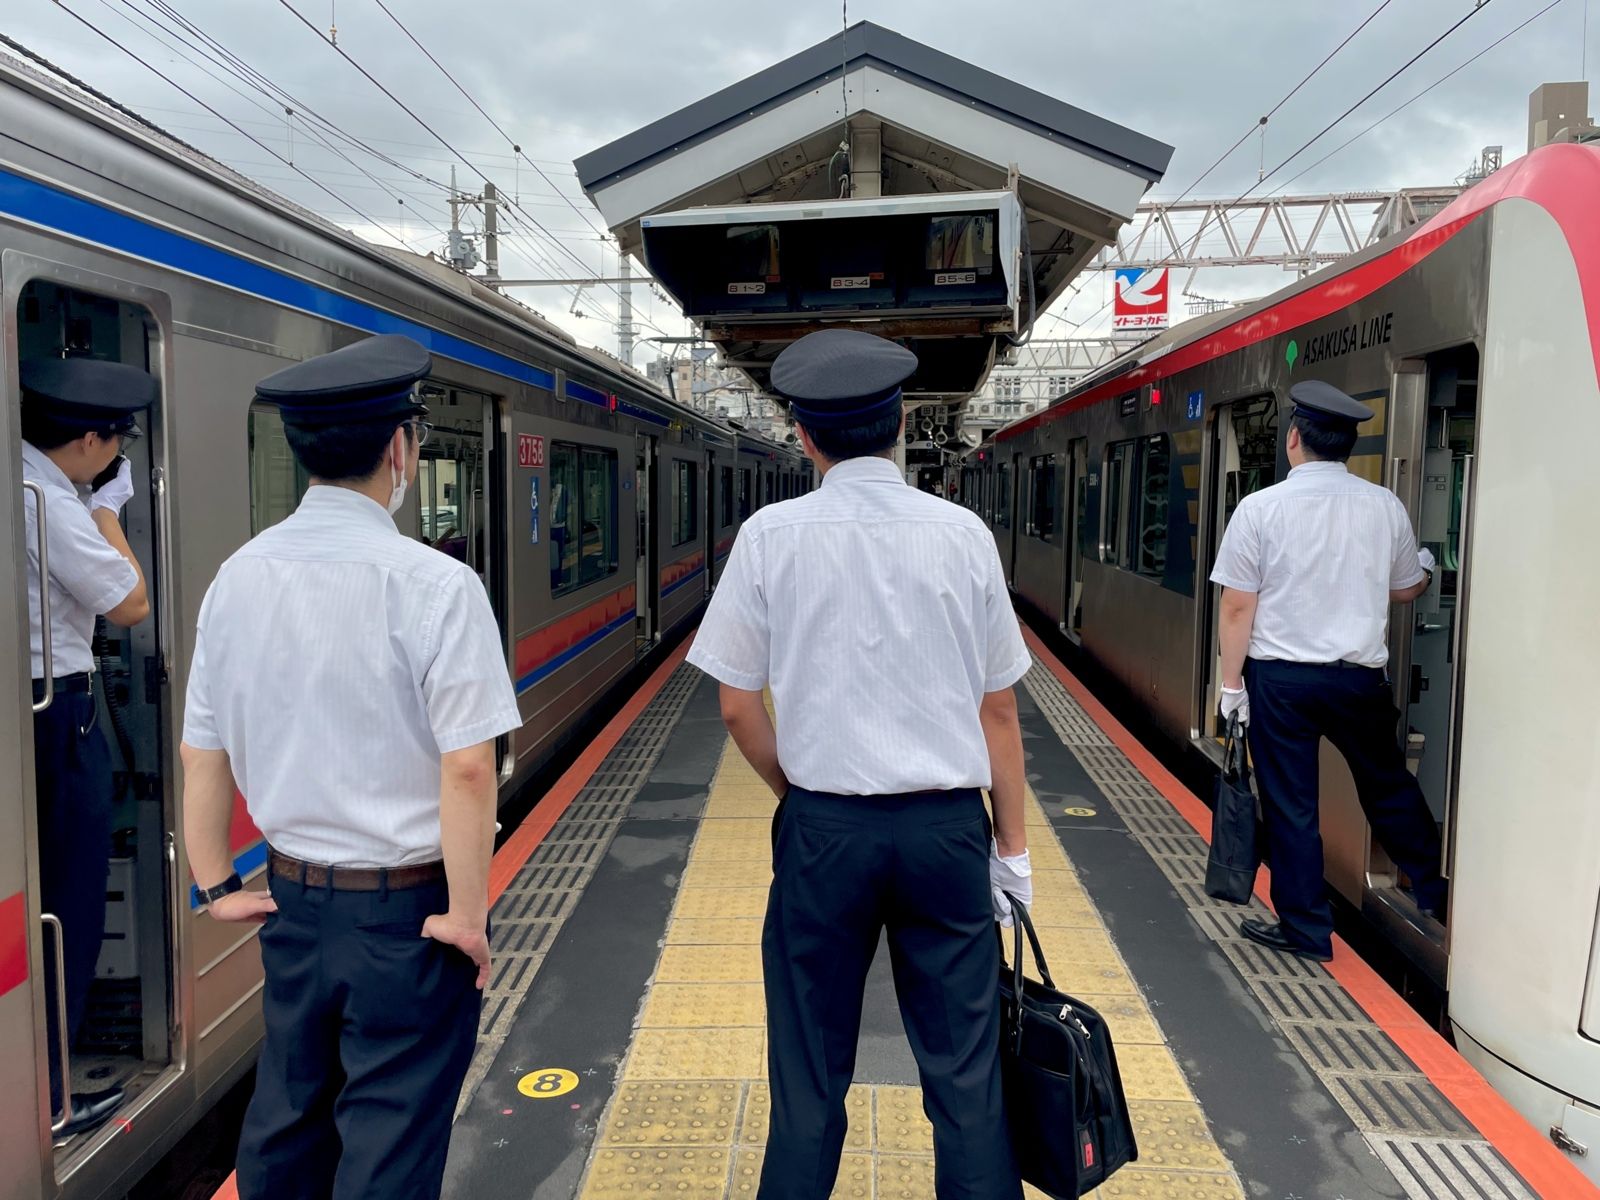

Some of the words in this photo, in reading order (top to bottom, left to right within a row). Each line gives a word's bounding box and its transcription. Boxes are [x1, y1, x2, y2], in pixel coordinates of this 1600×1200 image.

[1113, 316, 1168, 327] イトーヨーカドー
[1303, 325, 1356, 367] ASAKUSA
[1360, 312, 1393, 350] LINE
[519, 437, 544, 464] 3758
[533, 1073, 562, 1092] 8
